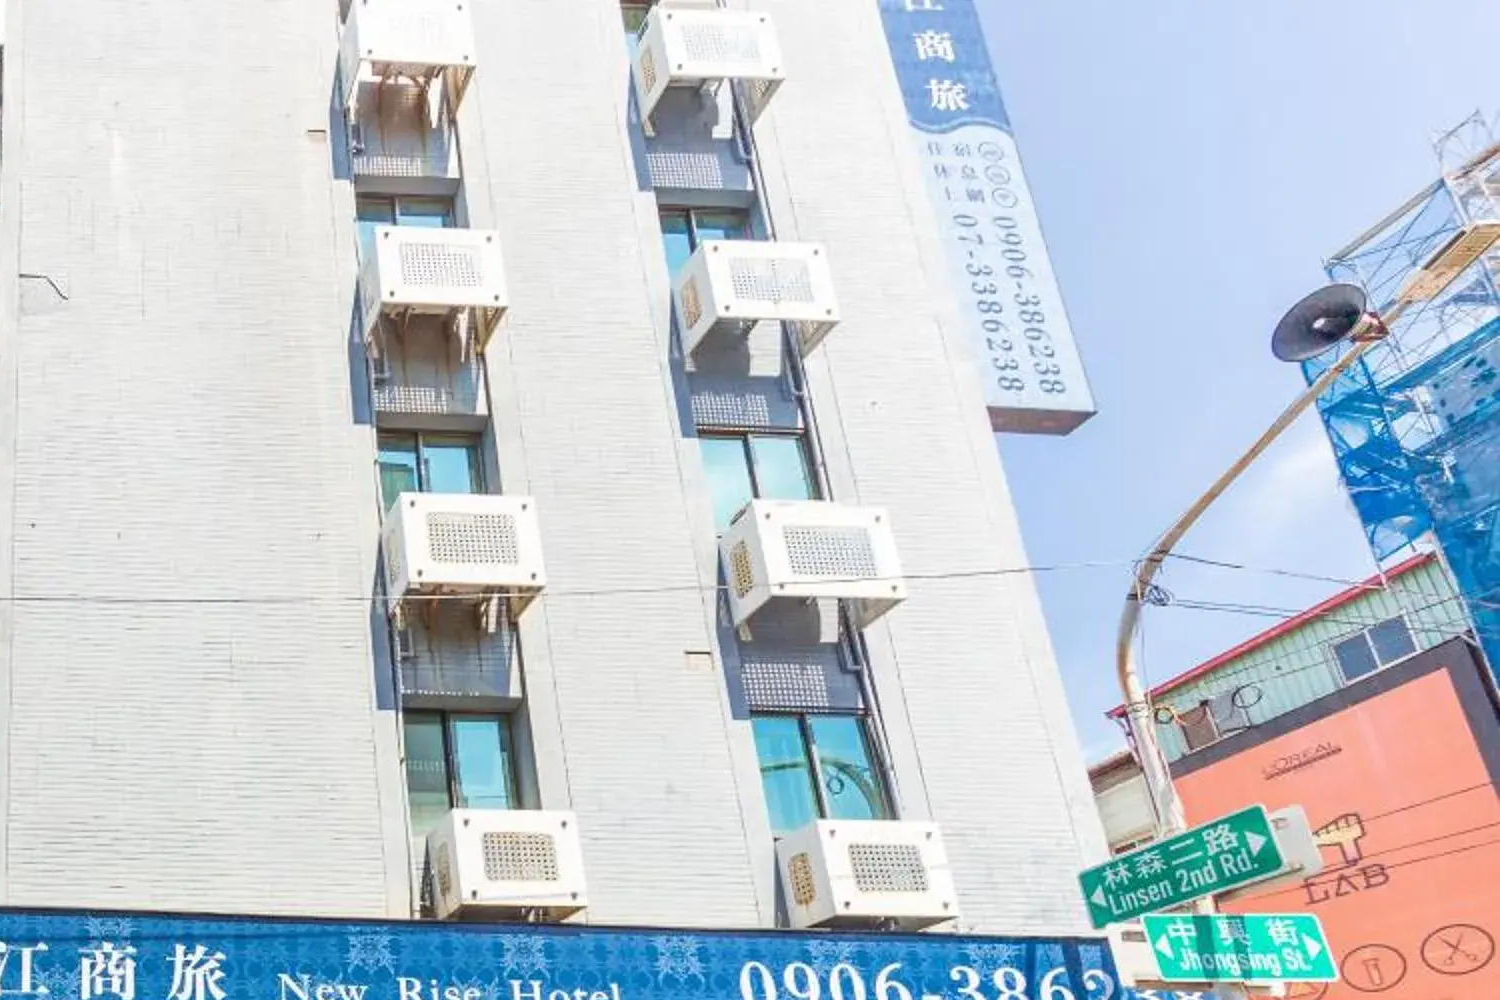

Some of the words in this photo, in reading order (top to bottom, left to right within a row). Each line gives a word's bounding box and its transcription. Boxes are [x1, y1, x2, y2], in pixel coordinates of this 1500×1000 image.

[993, 215, 1066, 395] 0906-386238
[1103, 823, 1241, 888] 林森二路
[1108, 880, 1173, 916] Linsen
[1180, 859, 1217, 893] 2nd
[1223, 849, 1259, 880] Rd.
[1300, 864, 1390, 905] LAB
[1167, 918, 1299, 947] 中興街
[1180, 947, 1282, 978] Jhongsing
[1285, 948, 1311, 971] St.
